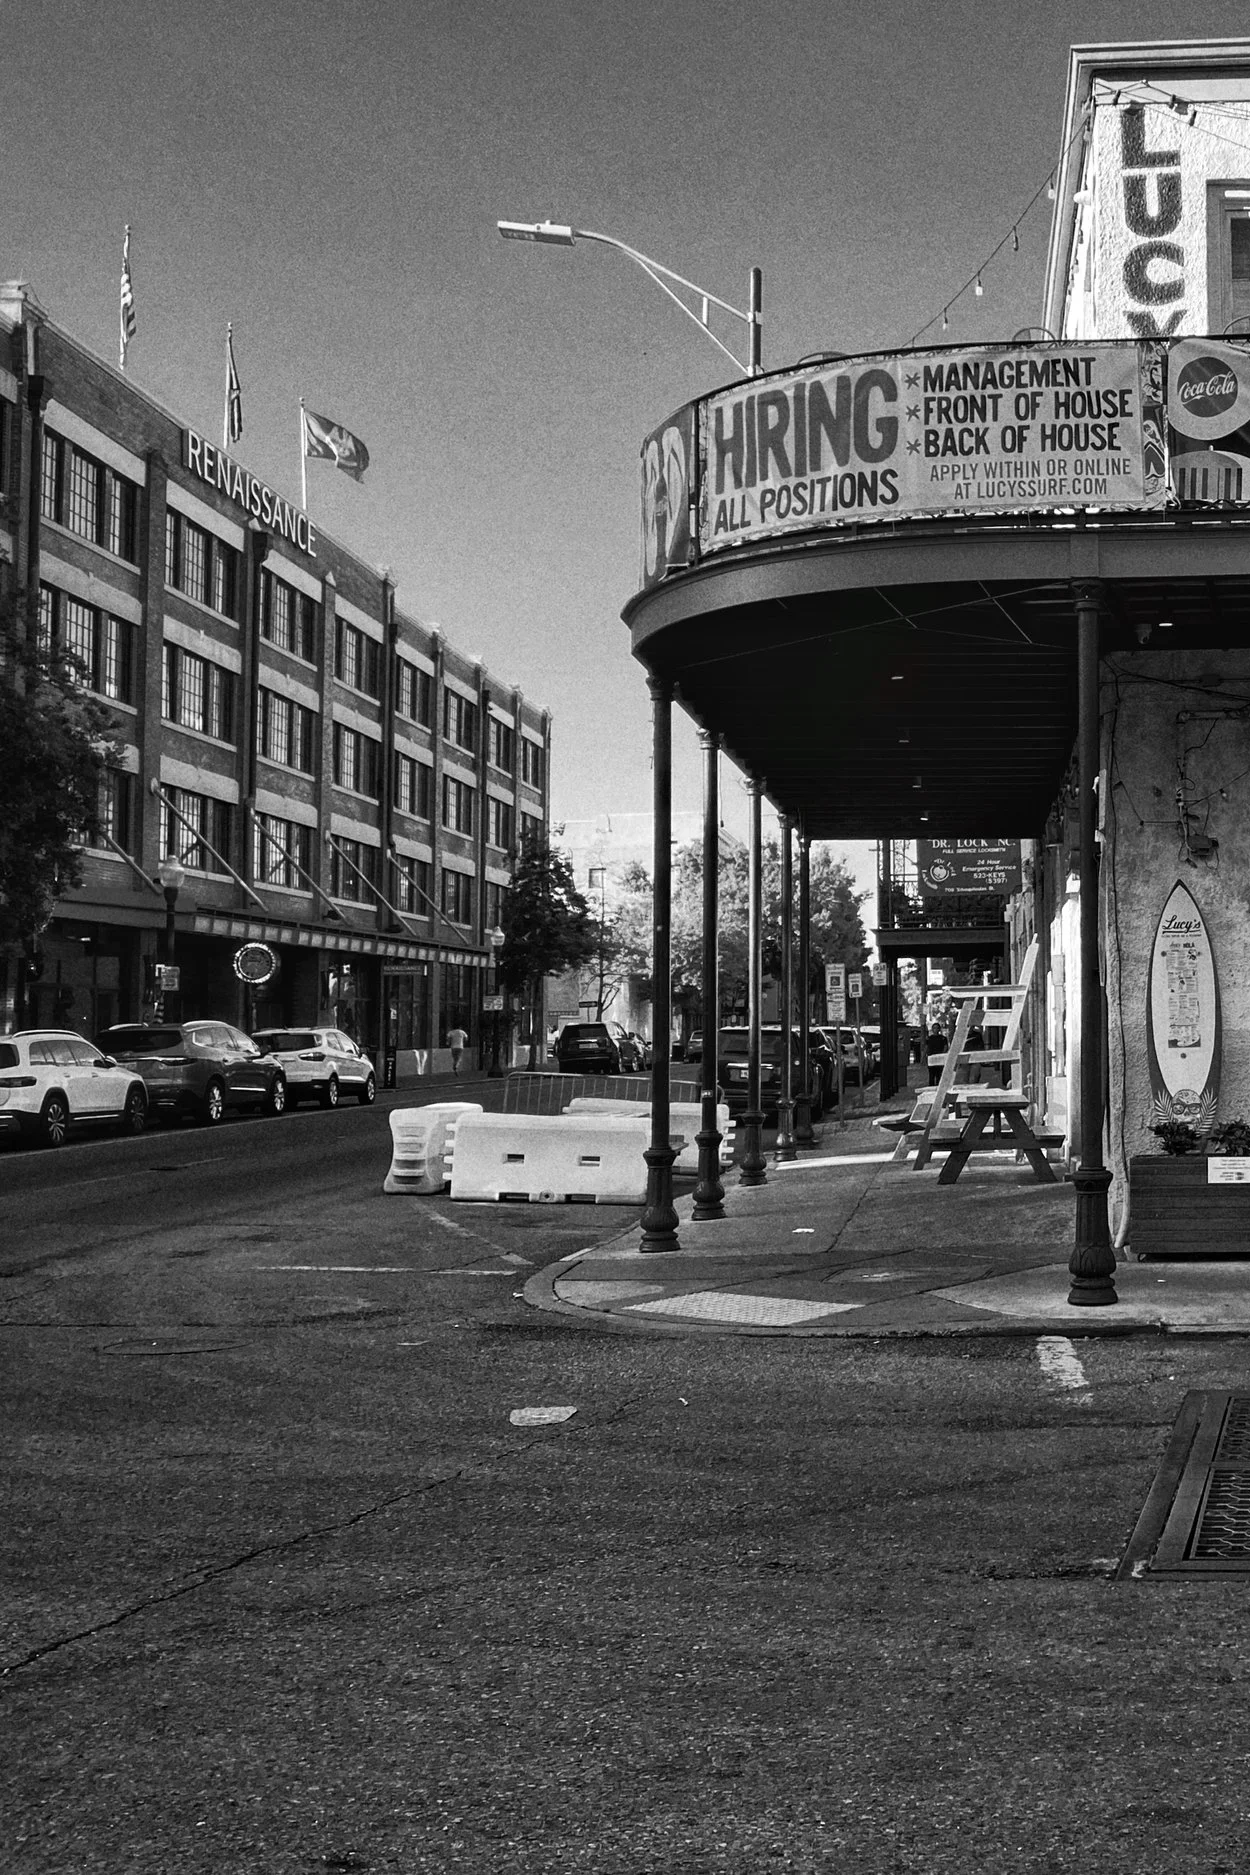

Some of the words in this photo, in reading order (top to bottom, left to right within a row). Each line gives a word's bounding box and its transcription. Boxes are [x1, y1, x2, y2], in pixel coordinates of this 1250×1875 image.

[923, 357, 1096, 392] MANAGEMENT
[1179, 371, 1235, 405] Coca-Cola
[924, 393, 1003, 425] FRONT
[1014, 391, 1043, 421] OF
[1054, 389, 1133, 419] HOUSE
[715, 369, 899, 495] HIRING
[924, 427, 990, 457] BACK
[1001, 425, 1030, 453] OF
[1041, 422, 1121, 452] HOUSE
[930, 463, 979, 481] APPLY
[984, 459, 1041, 479] WITHIN
[1046, 458, 1067, 475] OR
[1074, 457, 1131, 475] ONLINE
[188, 429, 316, 557] RENAISSANCE
[715, 495, 751, 536] ALL
[760, 469, 899, 523] POSITIONS
[954, 482, 971, 499] AT
[977, 478, 1107, 499] LUCYSSURF.COM
[932, 839, 951, 849] DR.
[957, 839, 989, 848] LOCK
[1162, 915, 1200, 933] Lucy's
